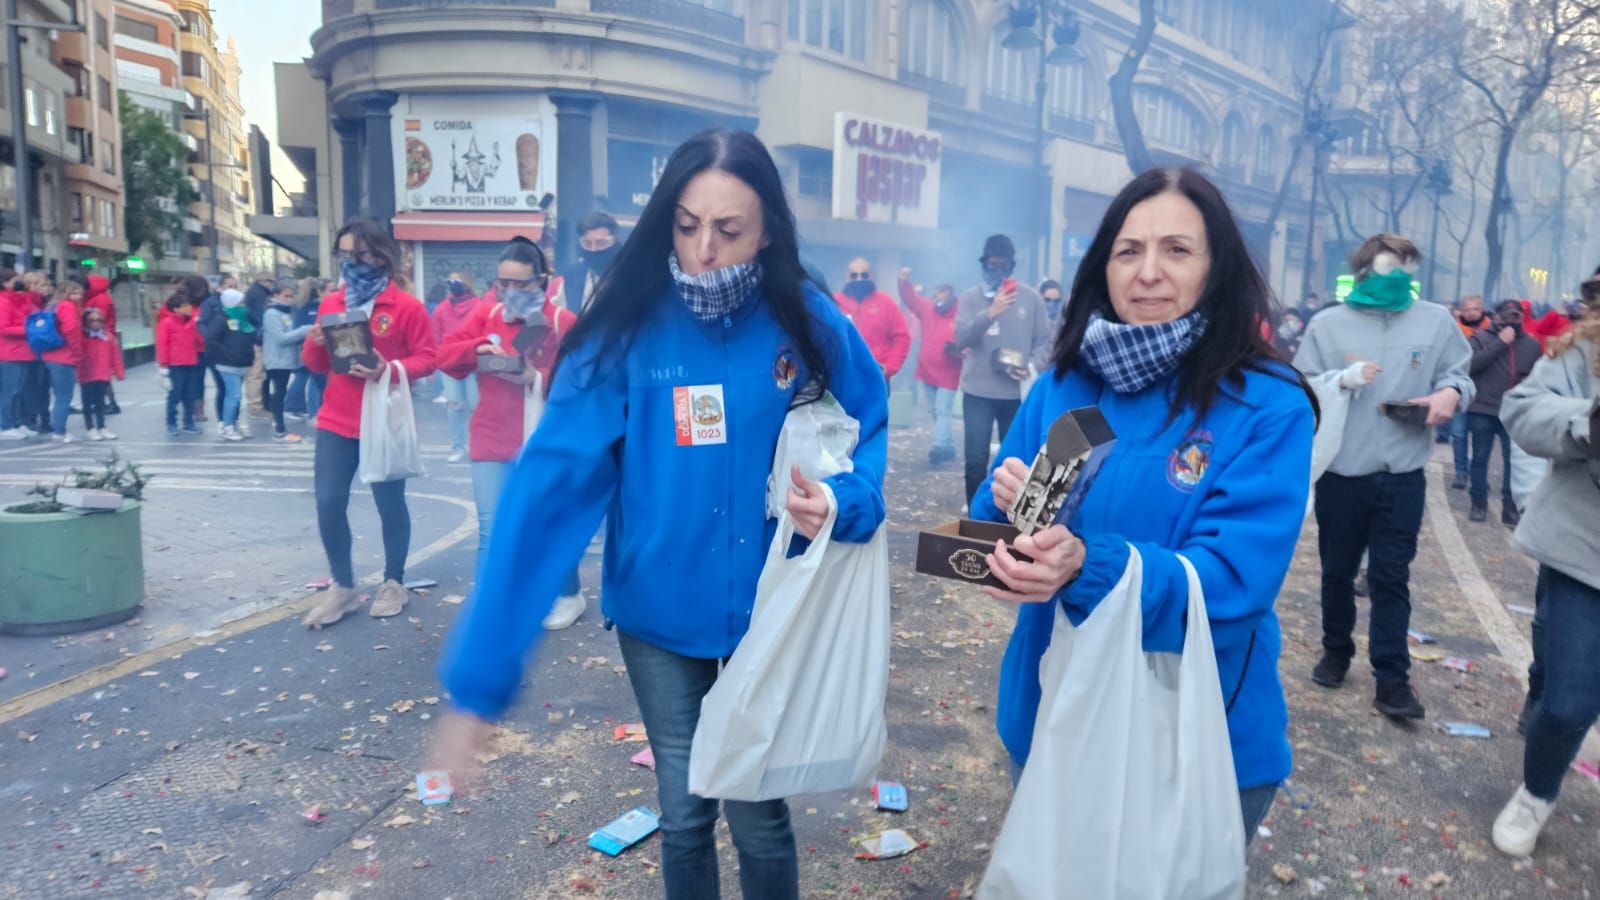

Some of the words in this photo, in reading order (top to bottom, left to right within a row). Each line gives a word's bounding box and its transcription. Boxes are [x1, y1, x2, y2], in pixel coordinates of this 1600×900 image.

[433, 120, 473, 131] COMIDA
[844, 119, 941, 162] CALZADOS
[856, 153, 927, 223] gaspar
[464, 196, 486, 207] PIZZA
[697, 428, 721, 440] 1023
